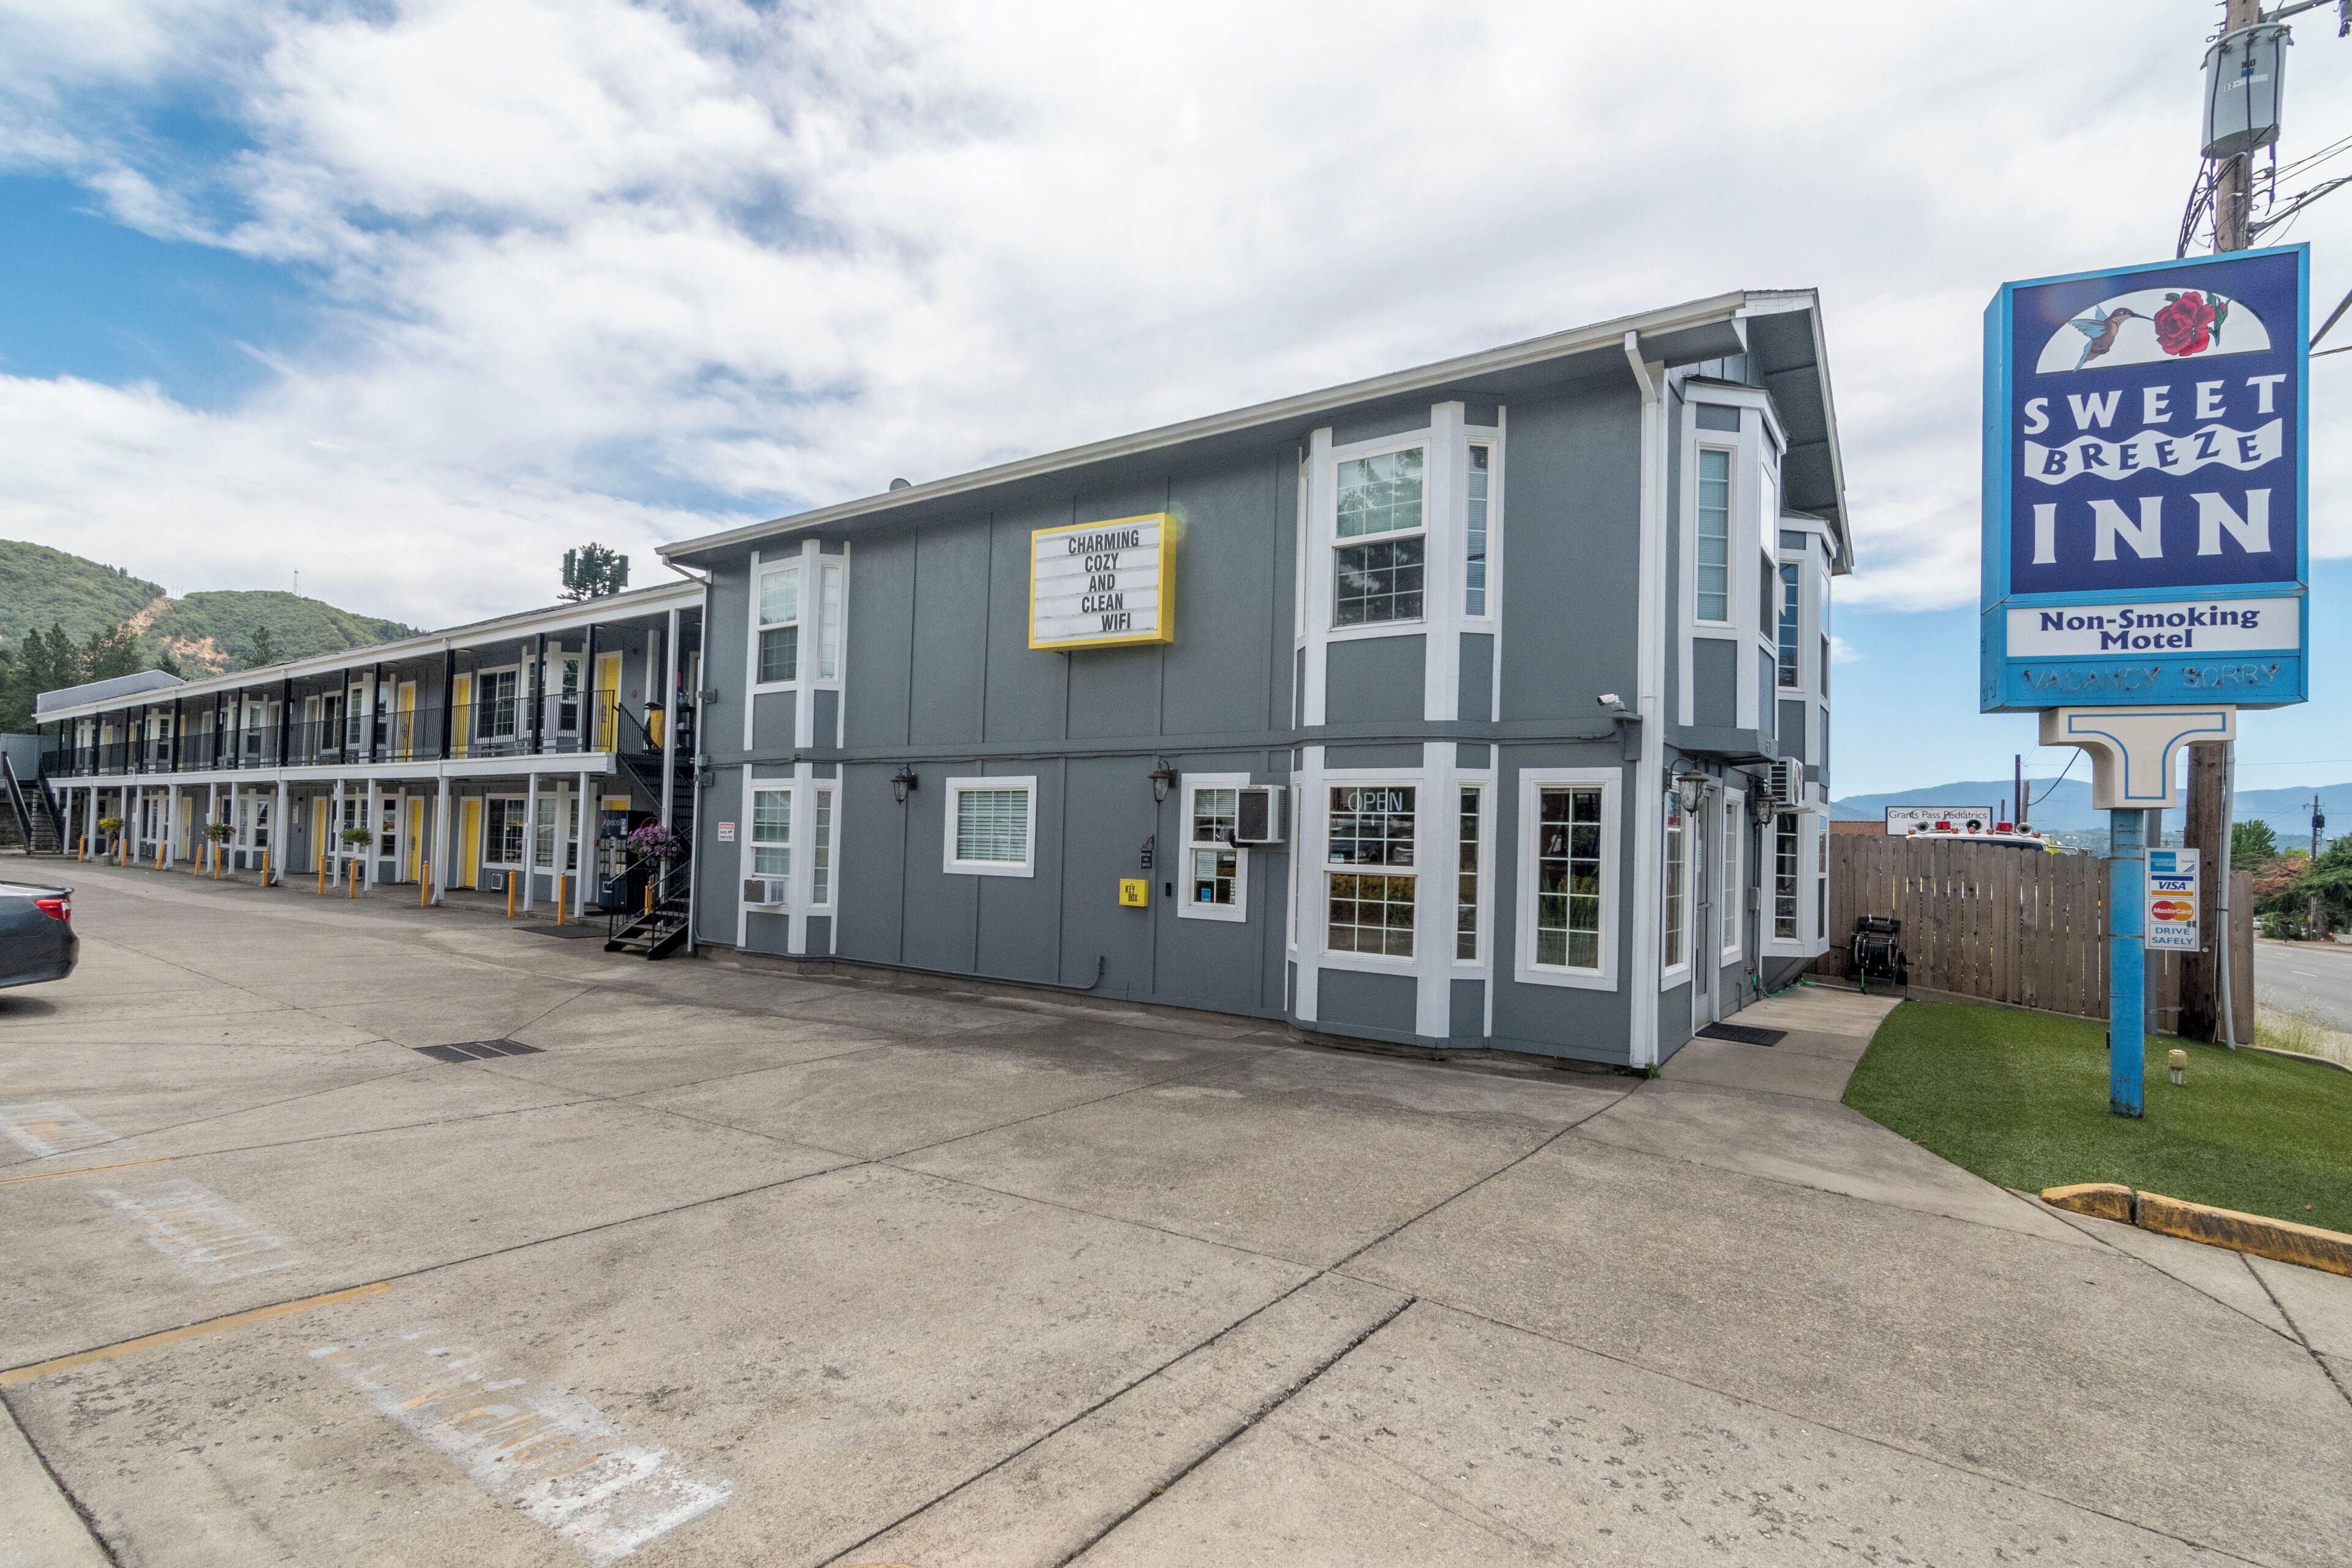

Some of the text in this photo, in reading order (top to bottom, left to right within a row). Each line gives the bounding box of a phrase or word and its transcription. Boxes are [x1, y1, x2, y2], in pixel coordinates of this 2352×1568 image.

[2024, 374, 2286, 434] SWEET
[2041, 430, 2262, 476] BREEZE
[2032, 489, 2272, 565] INN
[1068, 530, 1139, 554] CHARMING
[1085, 552, 1119, 573] COZY
[1088, 573, 1115, 592] AND
[1082, 593, 1123, 613] CLEAN
[1101, 612, 1131, 631] WIFI
[2039, 605, 2261, 631] Non-Smoking
[2099, 628, 2193, 650] Motel
[2023, 663, 2280, 693] VACANCY SORRY
[1348, 792, 1403, 812] OPEN
[1889, 810, 1987, 819] Grants Pass Pediatrics
[1125, 885, 1135, 894] KEY
[2158, 881, 2186, 890] VISA
[1128, 894, 1137, 902] BOX
[2152, 937, 2193, 945] SAFELY
